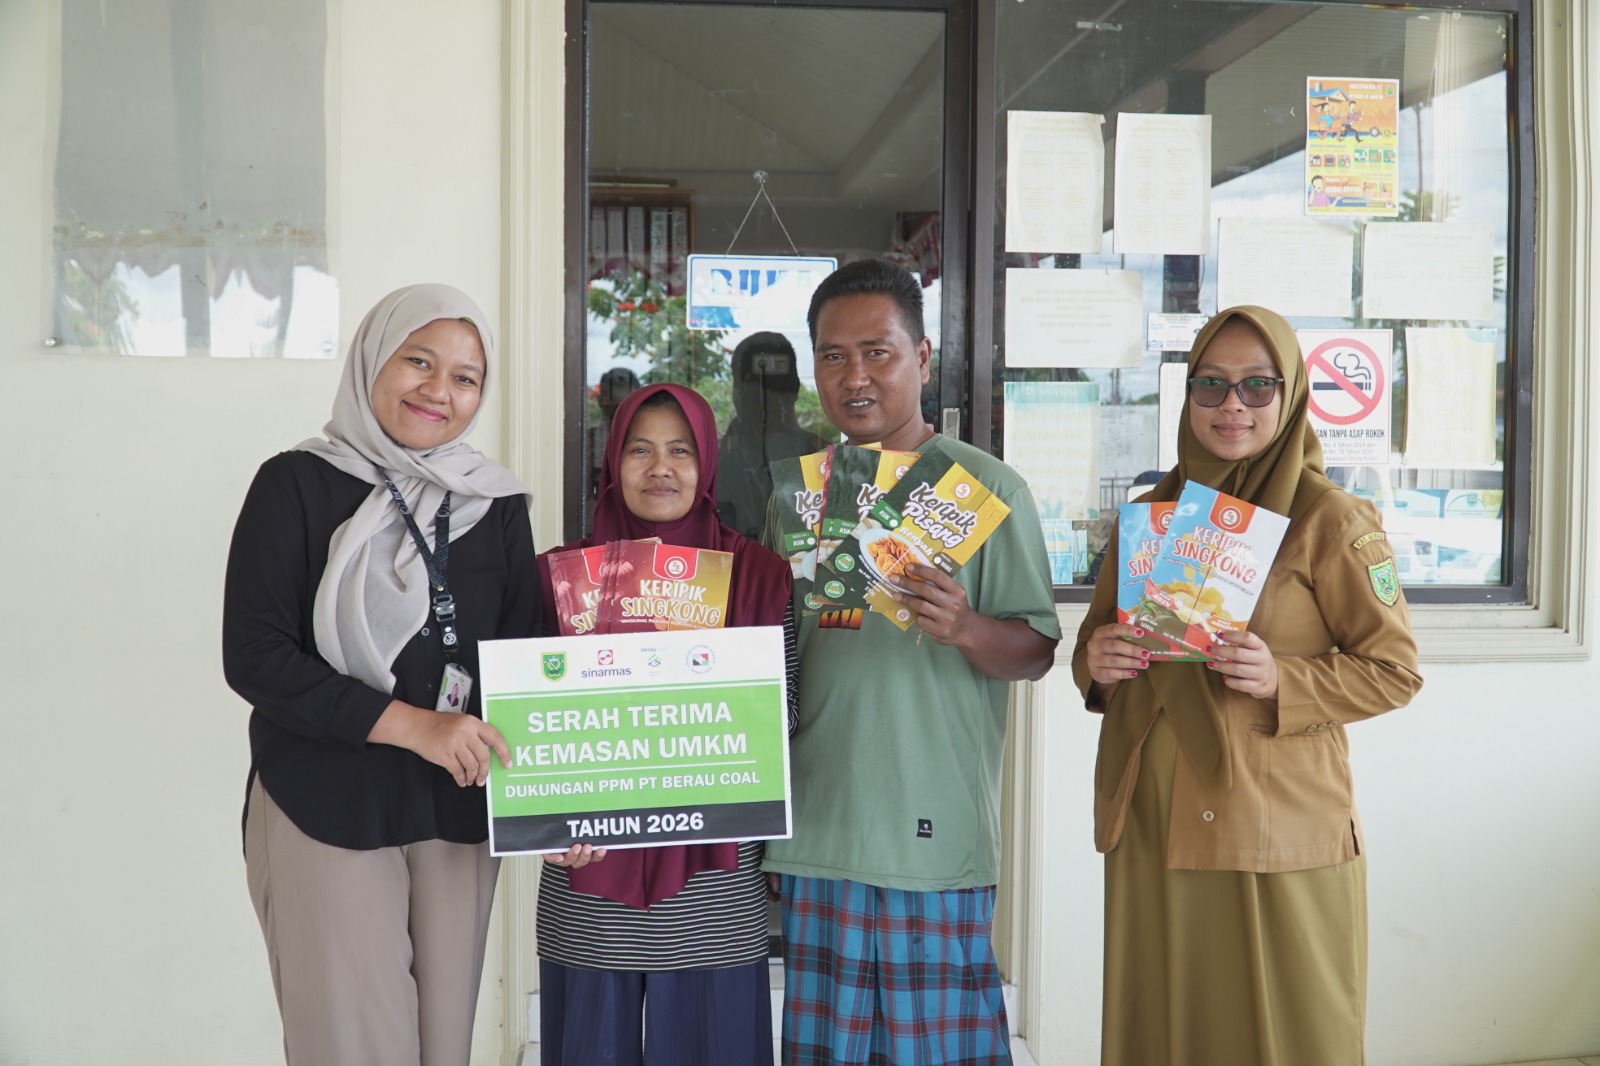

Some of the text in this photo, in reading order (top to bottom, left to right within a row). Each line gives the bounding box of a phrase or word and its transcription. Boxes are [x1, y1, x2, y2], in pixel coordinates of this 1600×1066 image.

[1329, 429, 1347, 438] TANPA
[1349, 429, 1364, 438] ASAP
[1366, 429, 1385, 438] ROKOK
[909, 482, 977, 537] Keripik
[902, 502, 965, 548] Pisang
[1193, 526, 1252, 560] KERIPIK
[1173, 537, 1257, 584] SINGKONG
[640, 579, 707, 602] KERIPIK
[620, 597, 721, 626] SINGKONG
[581, 667, 632, 678] sinarmas
[528, 702, 733, 734] SERAH TERIMA
[515, 733, 747, 767] KEMASAN UMKM
[505, 771, 761, 798] DUKUNGAN PPM PT BERAU COAL
[567, 812, 704, 838] TAHUN 2026
